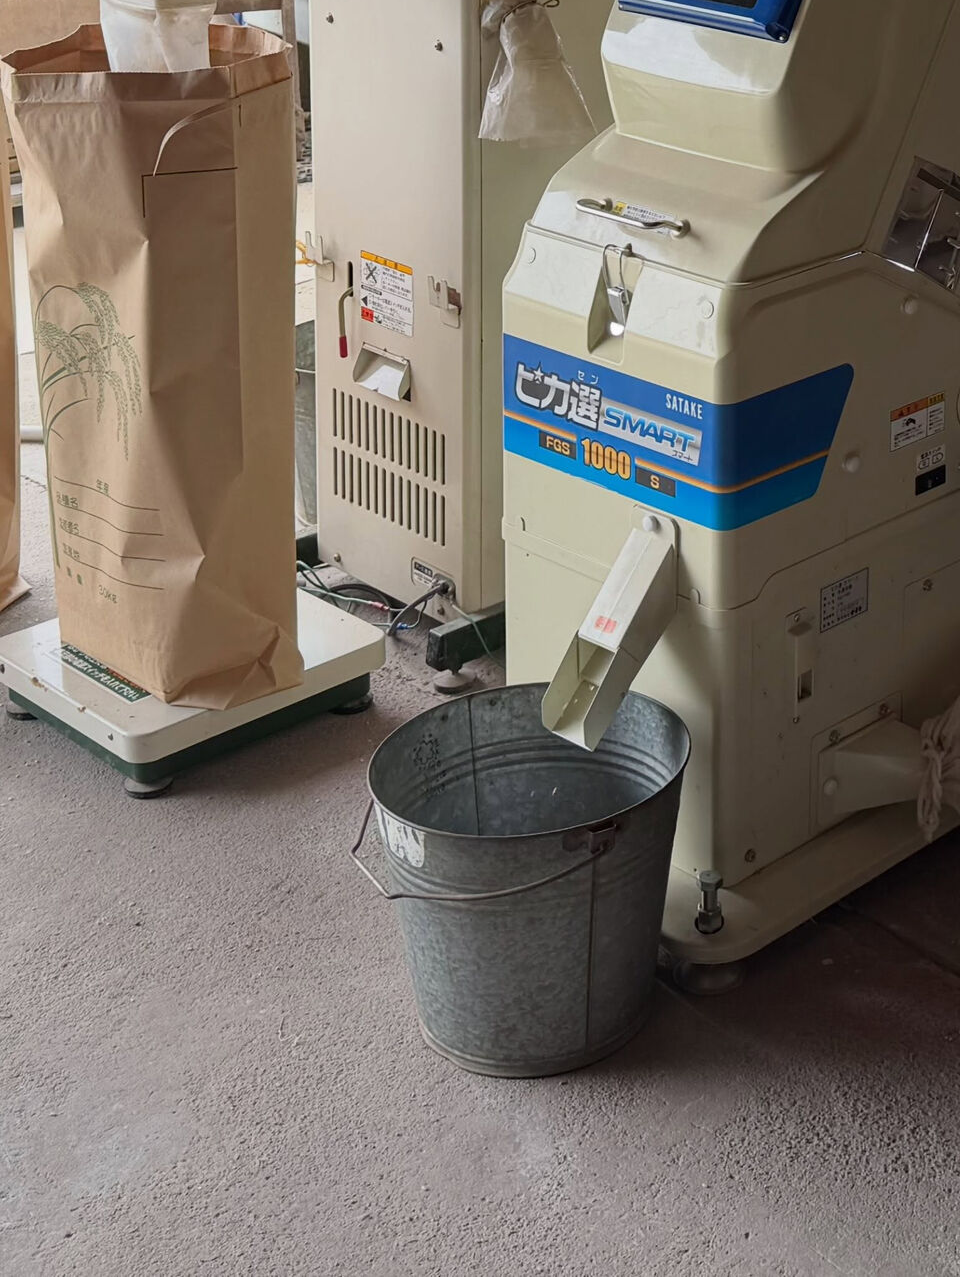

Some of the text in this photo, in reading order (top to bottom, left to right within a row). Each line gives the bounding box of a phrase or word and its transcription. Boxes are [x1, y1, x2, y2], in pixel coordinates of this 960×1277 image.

[603, 405, 696, 453] SMART
[665, 393, 703, 420] SATAKE
[546, 435, 660, 489] FGS 1000 S
